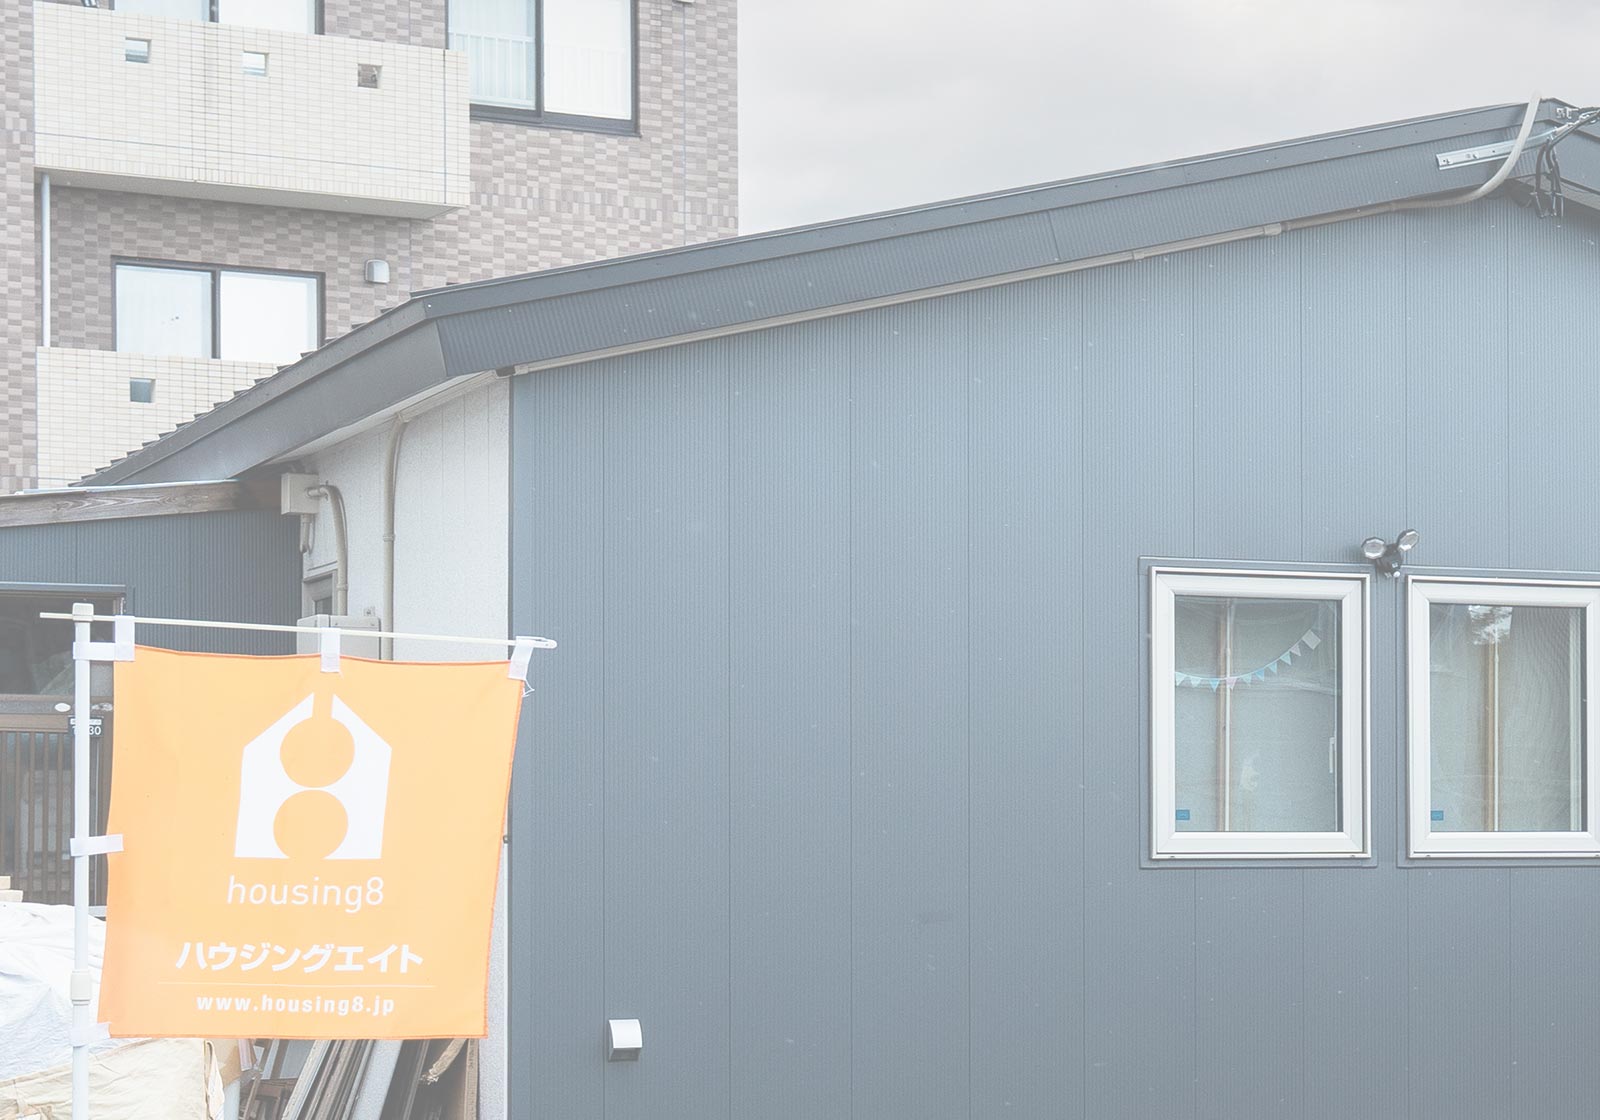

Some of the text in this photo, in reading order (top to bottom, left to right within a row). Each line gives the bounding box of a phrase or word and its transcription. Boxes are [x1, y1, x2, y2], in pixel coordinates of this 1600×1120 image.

[226, 874, 385, 914] housing8
[175, 941, 424, 974] ハウジングエイト
[196, 994, 395, 1016] www.housing8.jp
